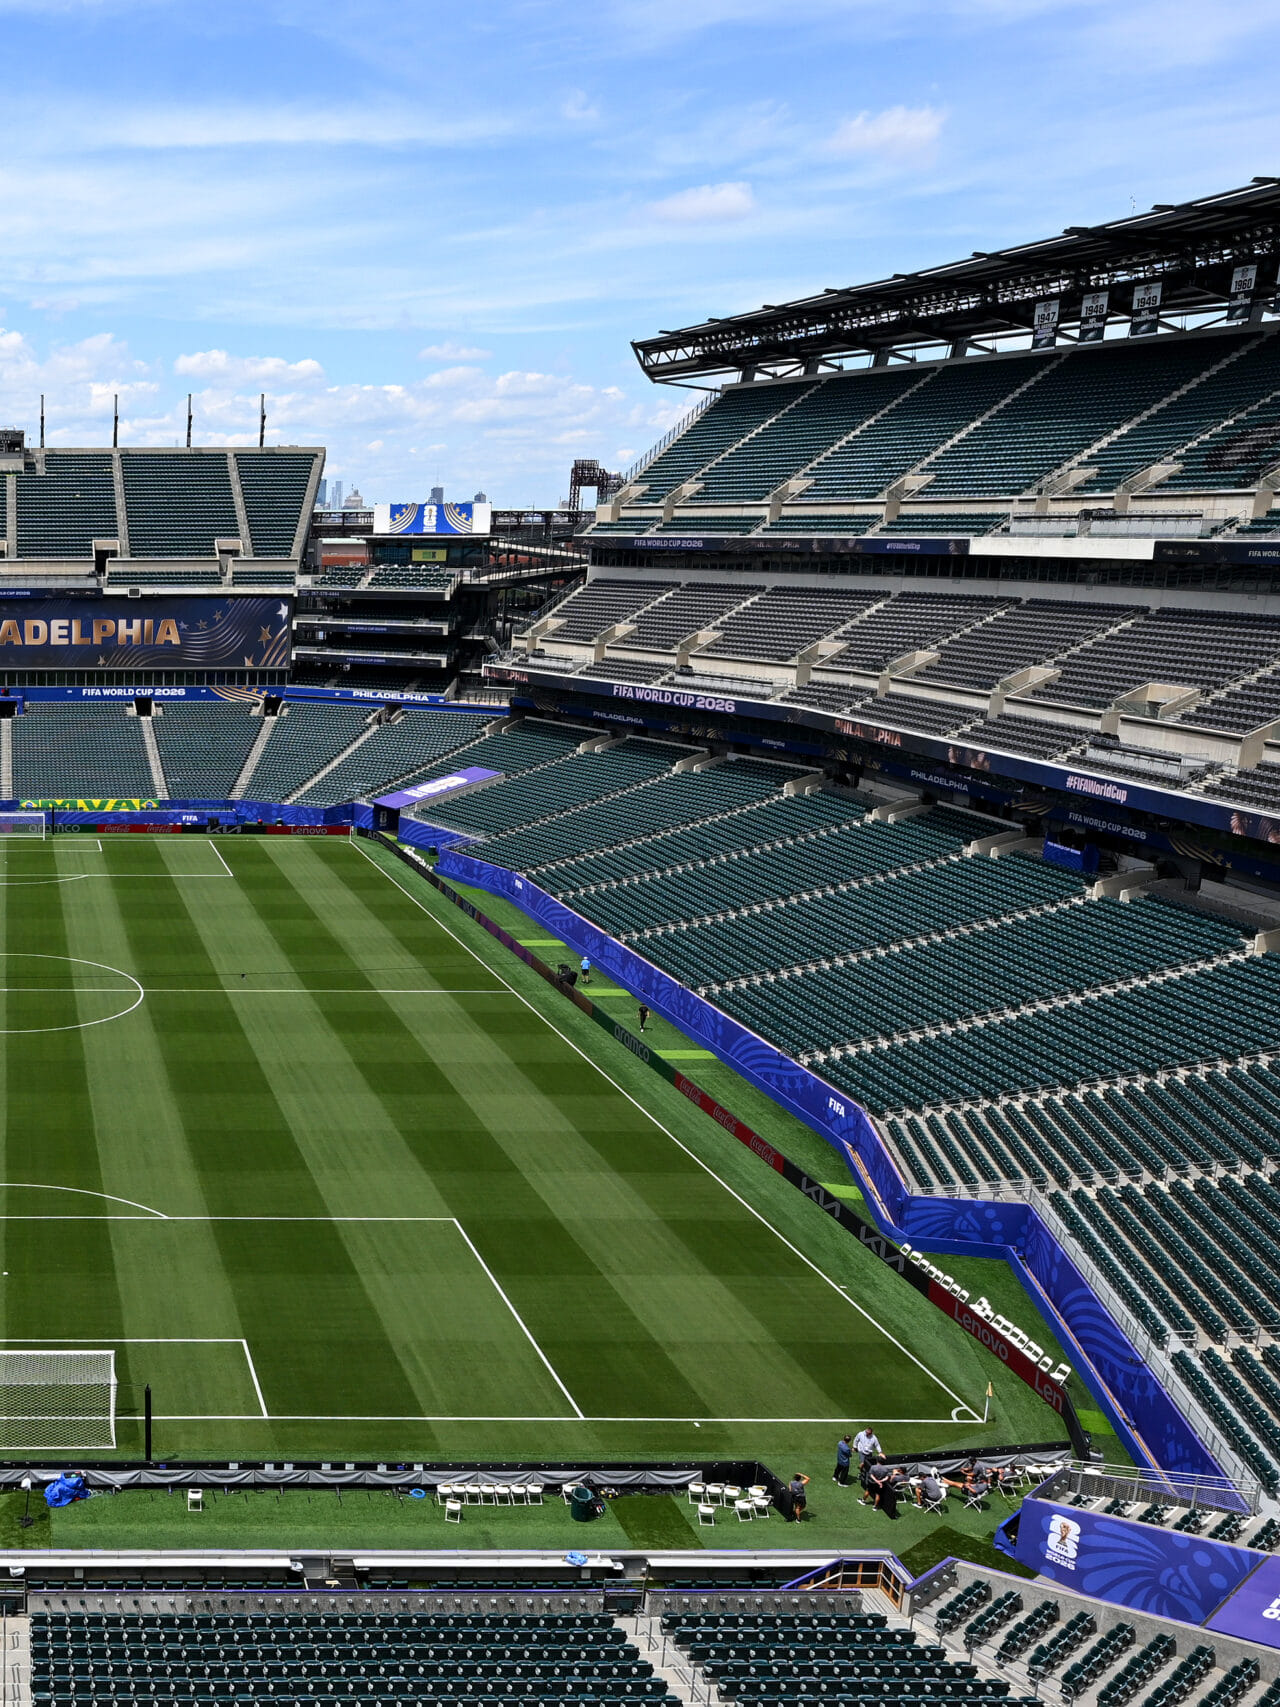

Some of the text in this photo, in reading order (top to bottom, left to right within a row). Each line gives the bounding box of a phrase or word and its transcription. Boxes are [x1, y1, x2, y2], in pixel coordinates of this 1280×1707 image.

[1234, 278, 1252, 290] 1960
[1136, 295, 1157, 308] 1949
[1085, 304, 1104, 316] 1948
[1037, 312, 1056, 323] 1947
[634, 539, 703, 548] FIFA WORLD CUP 2026
[82, 688, 186, 696] FIFA WORLD CUP 2026
[352, 690, 429, 702] PHILADELPHIA
[613, 685, 735, 712] FIFA WORLD CUP 2026
[593, 710, 643, 725] PHILADELPHIA
[911, 769, 969, 792] PHILADELPHIA
[1066, 775, 1127, 803] #FIFAWorldCup
[29, 823, 80, 833] aramco
[291, 826, 328, 835] Lenovo
[1069, 812, 1147, 840] FIFA WORLD CUP 2026
[614, 1025, 650, 1062] aramco
[829, 1097, 845, 1118] FIFA
[954, 1302, 1008, 1361] Lenovo
[1035, 1370, 1063, 1413] Len
[1055, 1544, 1069, 1554] FIFA
[1045, 1553, 1076, 1570] 2026
